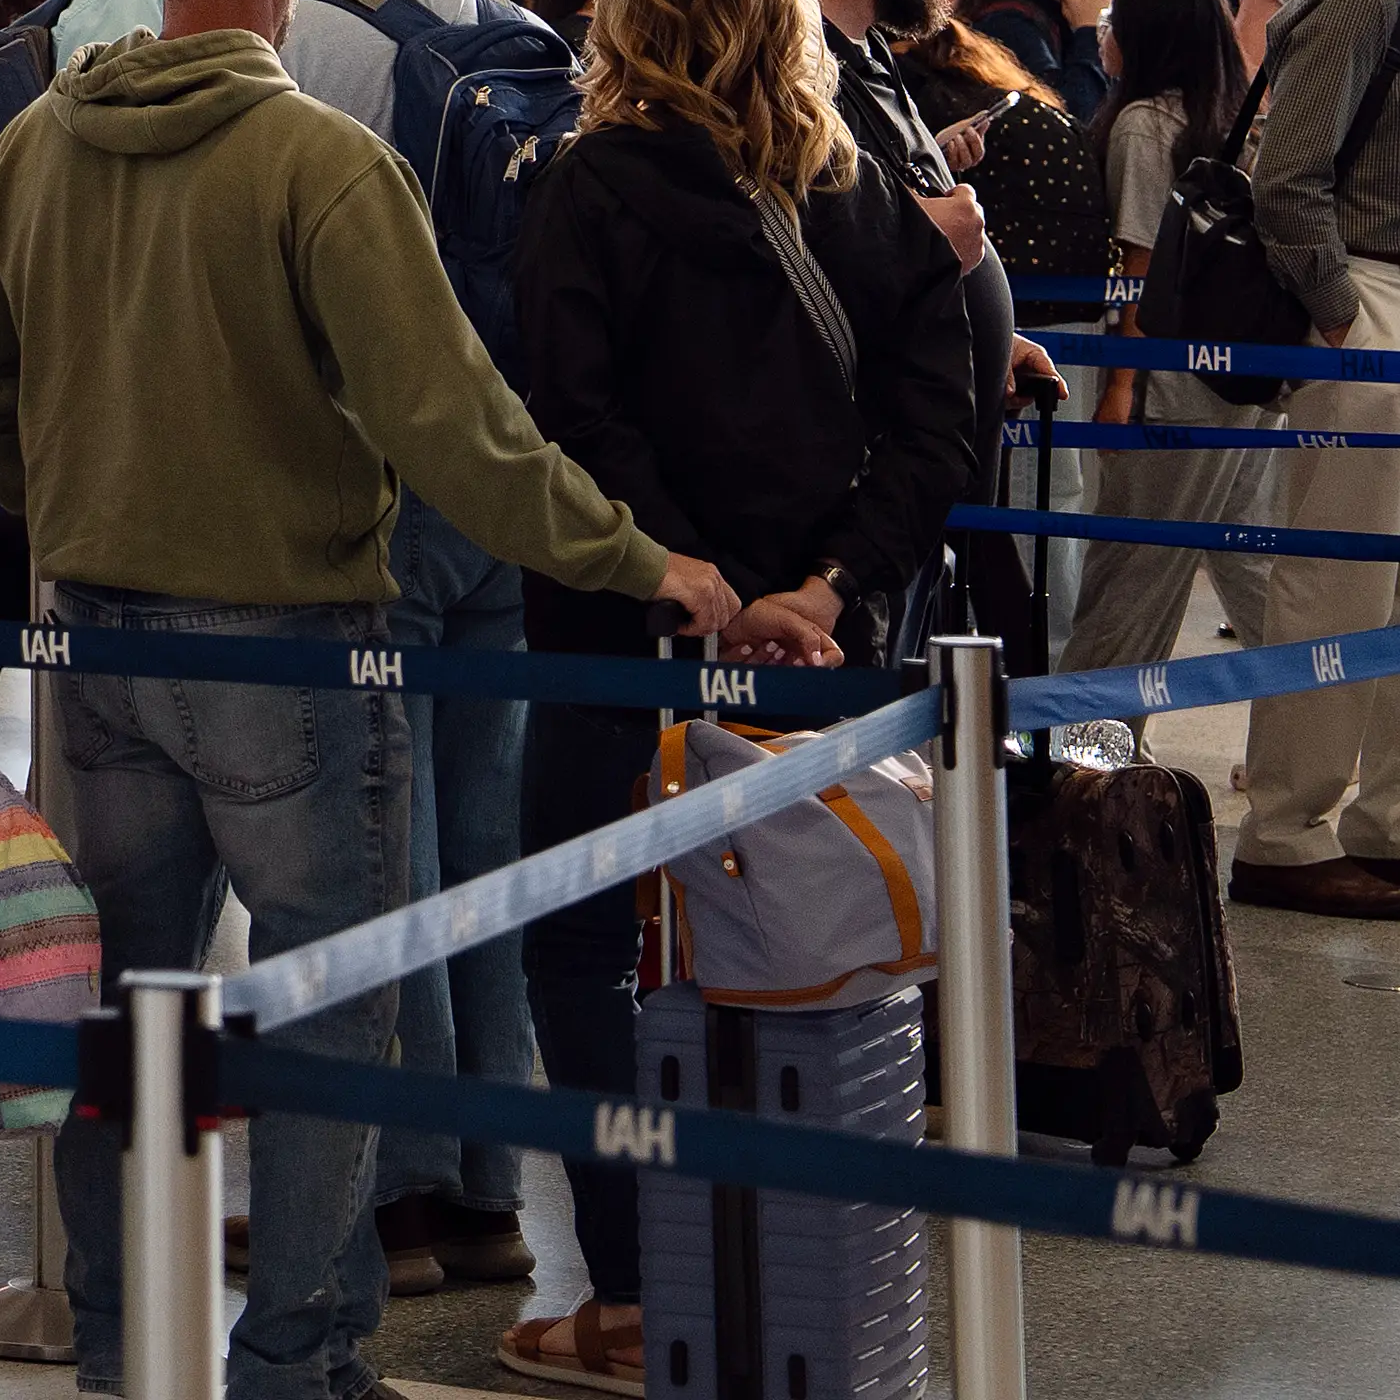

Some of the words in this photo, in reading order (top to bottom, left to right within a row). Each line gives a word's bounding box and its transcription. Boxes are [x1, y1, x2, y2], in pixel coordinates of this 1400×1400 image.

[1104, 278, 1144, 302] IAH
[1188, 344, 1231, 372] IAH
[22, 629, 70, 665] IAH
[1312, 642, 1346, 683] IAH
[350, 649, 403, 687] IAH
[700, 668, 756, 705] IAH
[1138, 665, 1172, 708] IAH
[595, 1103, 675, 1164] IAH
[1112, 1182, 1198, 1243] IAH
